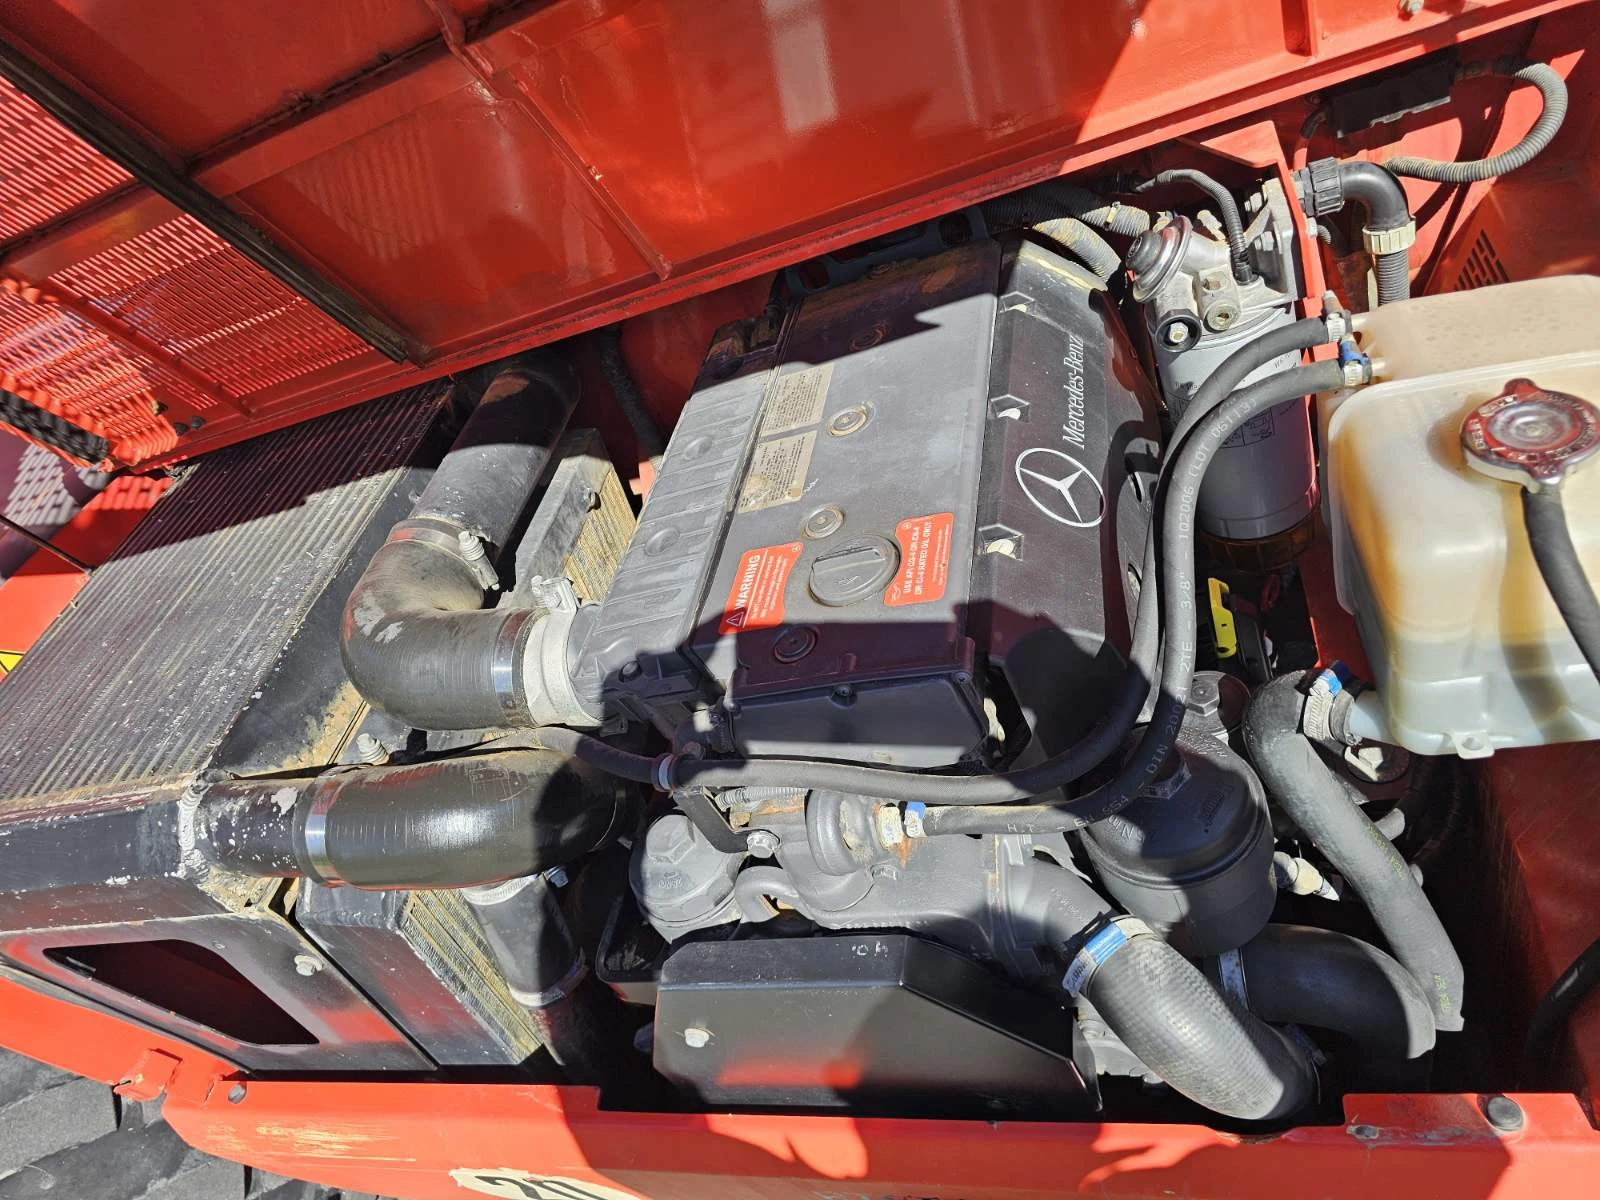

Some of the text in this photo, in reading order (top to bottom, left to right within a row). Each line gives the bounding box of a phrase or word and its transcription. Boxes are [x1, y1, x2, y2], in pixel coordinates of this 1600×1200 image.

[1062, 333, 1085, 451] Mercedes-Benz
[917, 549, 927, 570] RATED
[923, 521, 932, 538] ONLY
[735, 555, 760, 610] WARNING
[903, 579, 912, 593] USE
[1146, 743, 1169, 774] DIN
[1166, 686, 1188, 735] 20021
[1179, 640, 1193, 673] 2TE
